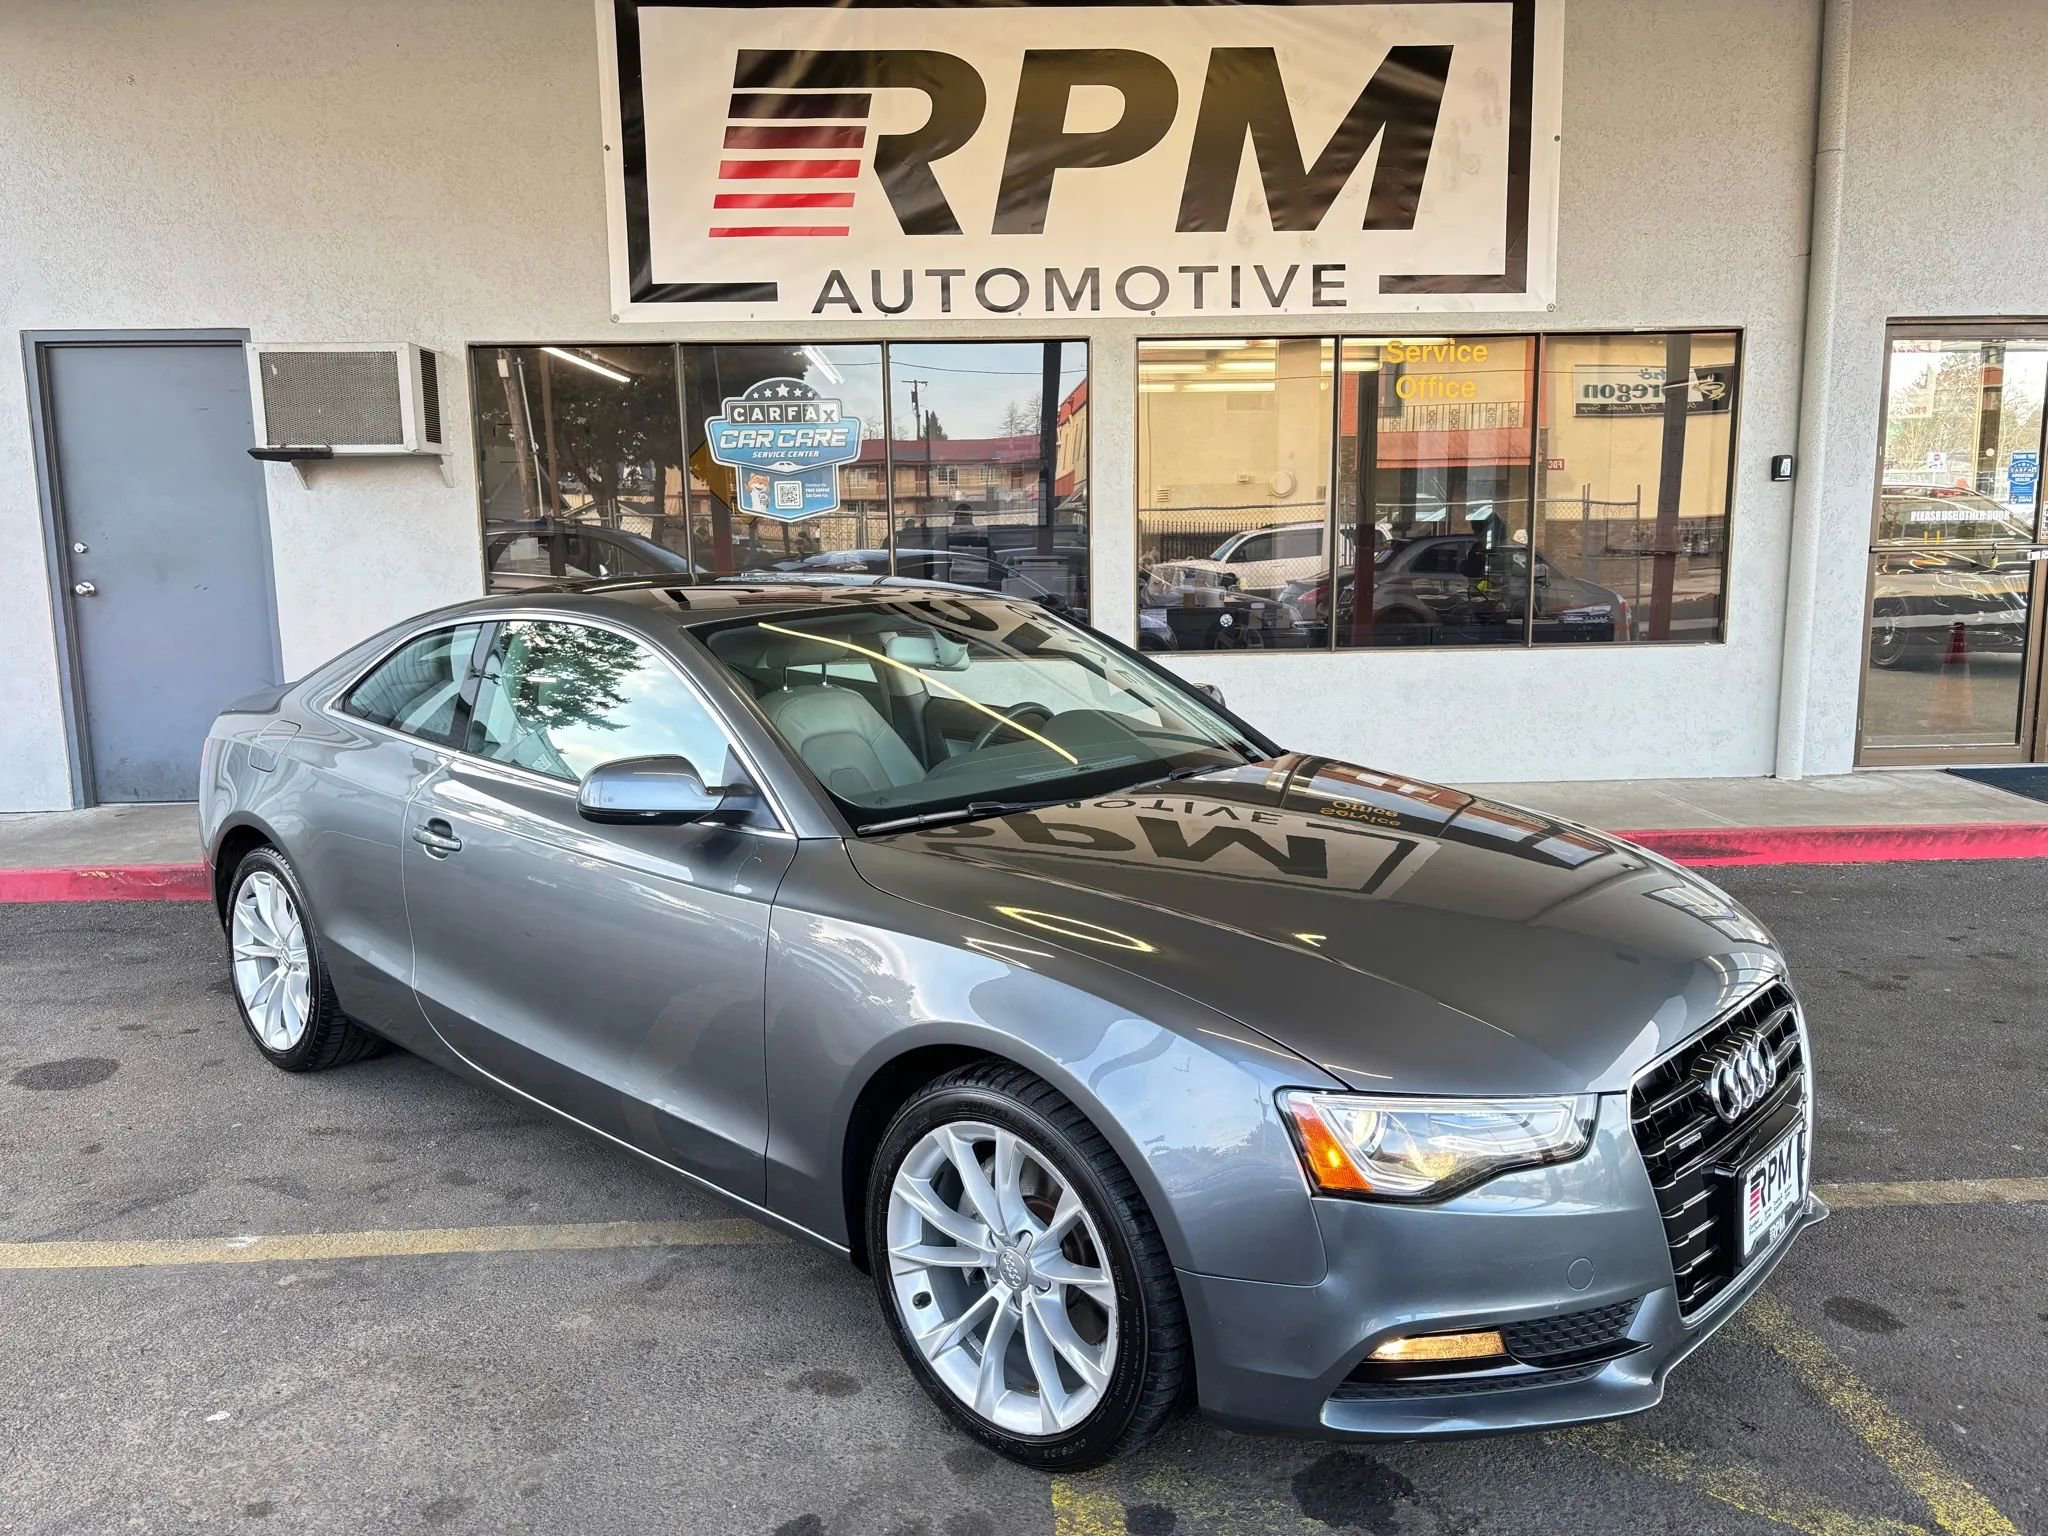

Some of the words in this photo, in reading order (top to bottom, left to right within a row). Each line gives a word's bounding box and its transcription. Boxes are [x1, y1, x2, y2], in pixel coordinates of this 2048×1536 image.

[708, 44, 1454, 238] RPM
[811, 262, 1349, 315] AUTOMOTIVE
[1386, 341, 1489, 364] Service
[1395, 375, 1477, 400] Office
[732, 405, 837, 423] CARFAX
[719, 429, 775, 449] CAR
[777, 428, 849, 448] CARE
[752, 451, 786, 459] SERVICE
[788, 450, 820, 458] CENTER
[1911, 510, 1941, 521] PLEASE
[1941, 510, 1959, 520] USE
[1959, 510, 1987, 520] OTHER
[1749, 1136, 1793, 1221] RPM
